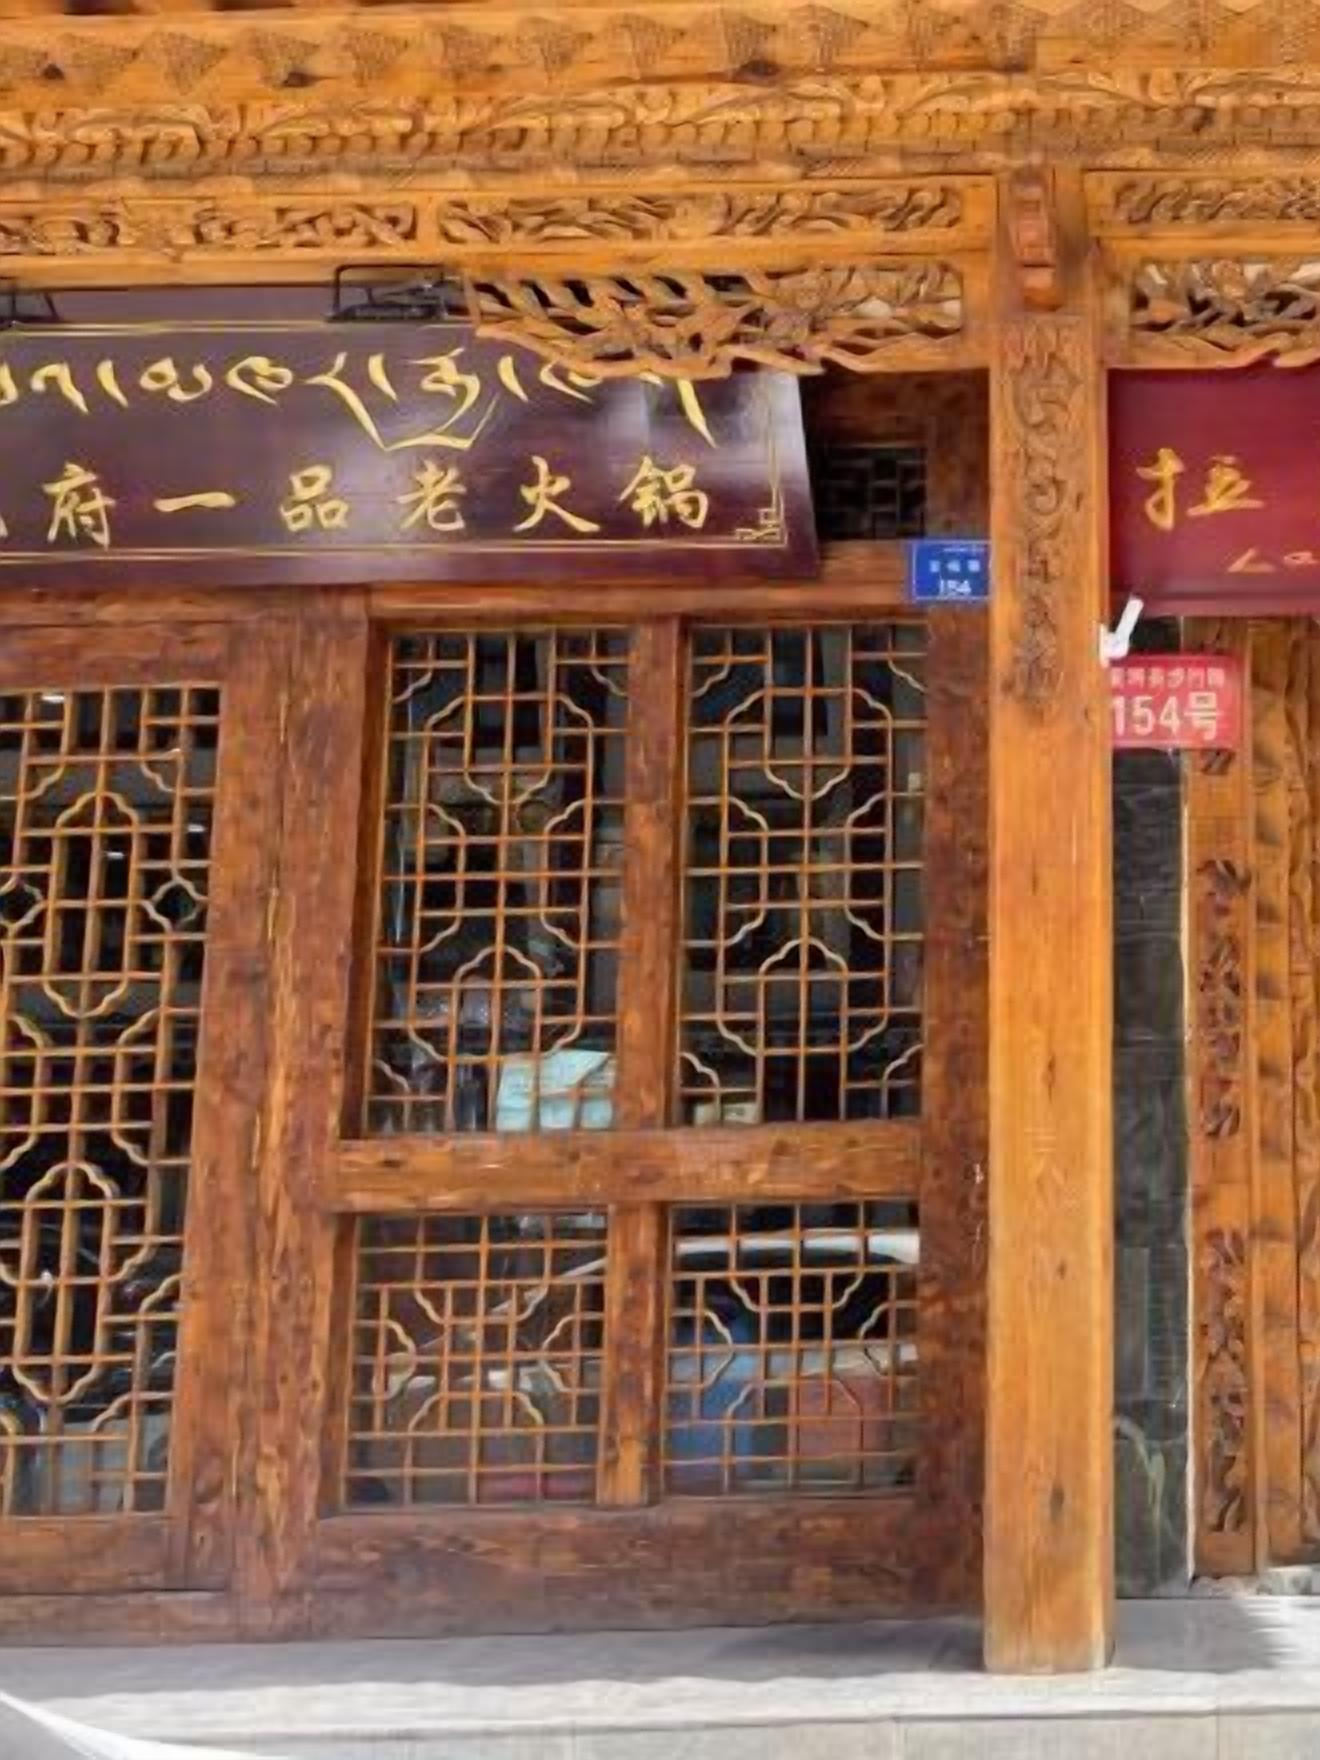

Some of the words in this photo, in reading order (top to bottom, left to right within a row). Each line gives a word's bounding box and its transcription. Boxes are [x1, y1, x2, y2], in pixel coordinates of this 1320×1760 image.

[0, 455, 709, 548] 府一品老火锅
[1112, 691, 1224, 741] 154号
